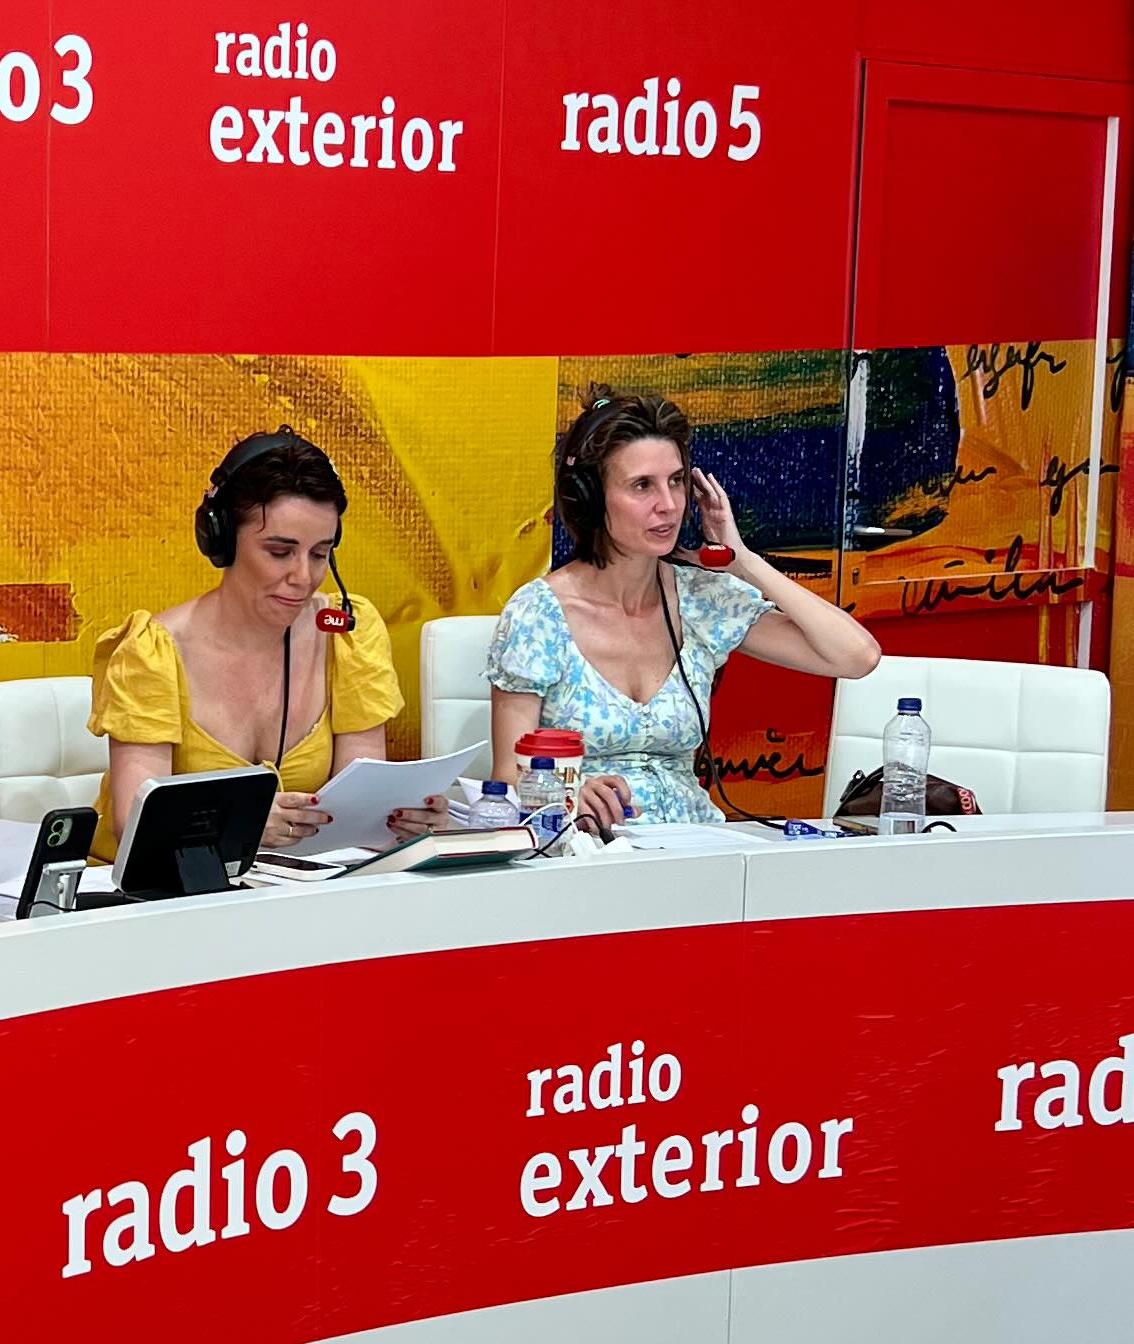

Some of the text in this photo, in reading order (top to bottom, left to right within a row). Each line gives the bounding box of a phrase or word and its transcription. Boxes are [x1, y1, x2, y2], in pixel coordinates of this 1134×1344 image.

[214, 22, 337, 82] radio
[209, 95, 464, 172] exterior
[526, 1039, 682, 1118] radio
[62, 1111, 378, 1279] radio 3
[520, 1103, 854, 1218] exterior
